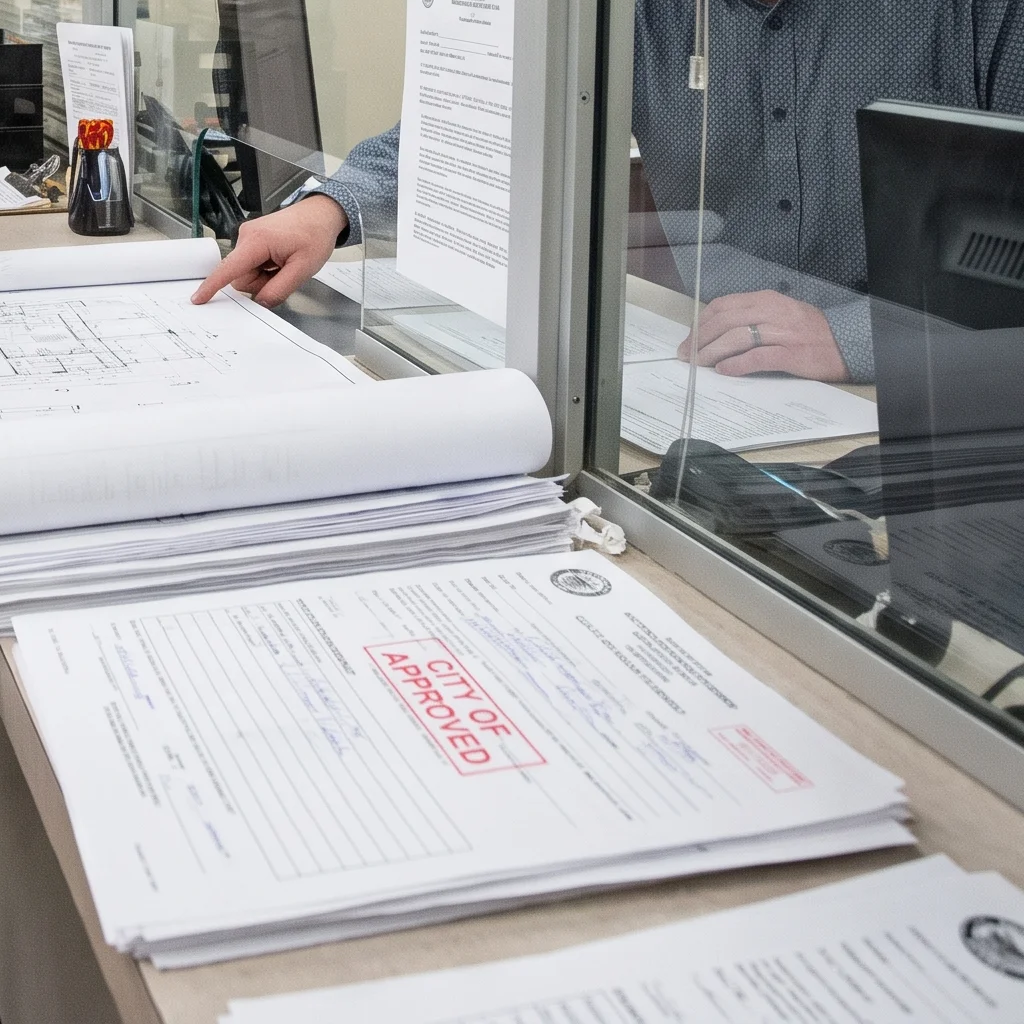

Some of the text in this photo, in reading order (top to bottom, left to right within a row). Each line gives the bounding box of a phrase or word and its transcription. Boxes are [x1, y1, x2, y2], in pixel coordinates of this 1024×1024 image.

[381, 653, 491, 764] APPROVED
[427, 660, 483, 701] CITY
[469, 709, 511, 736] OF
